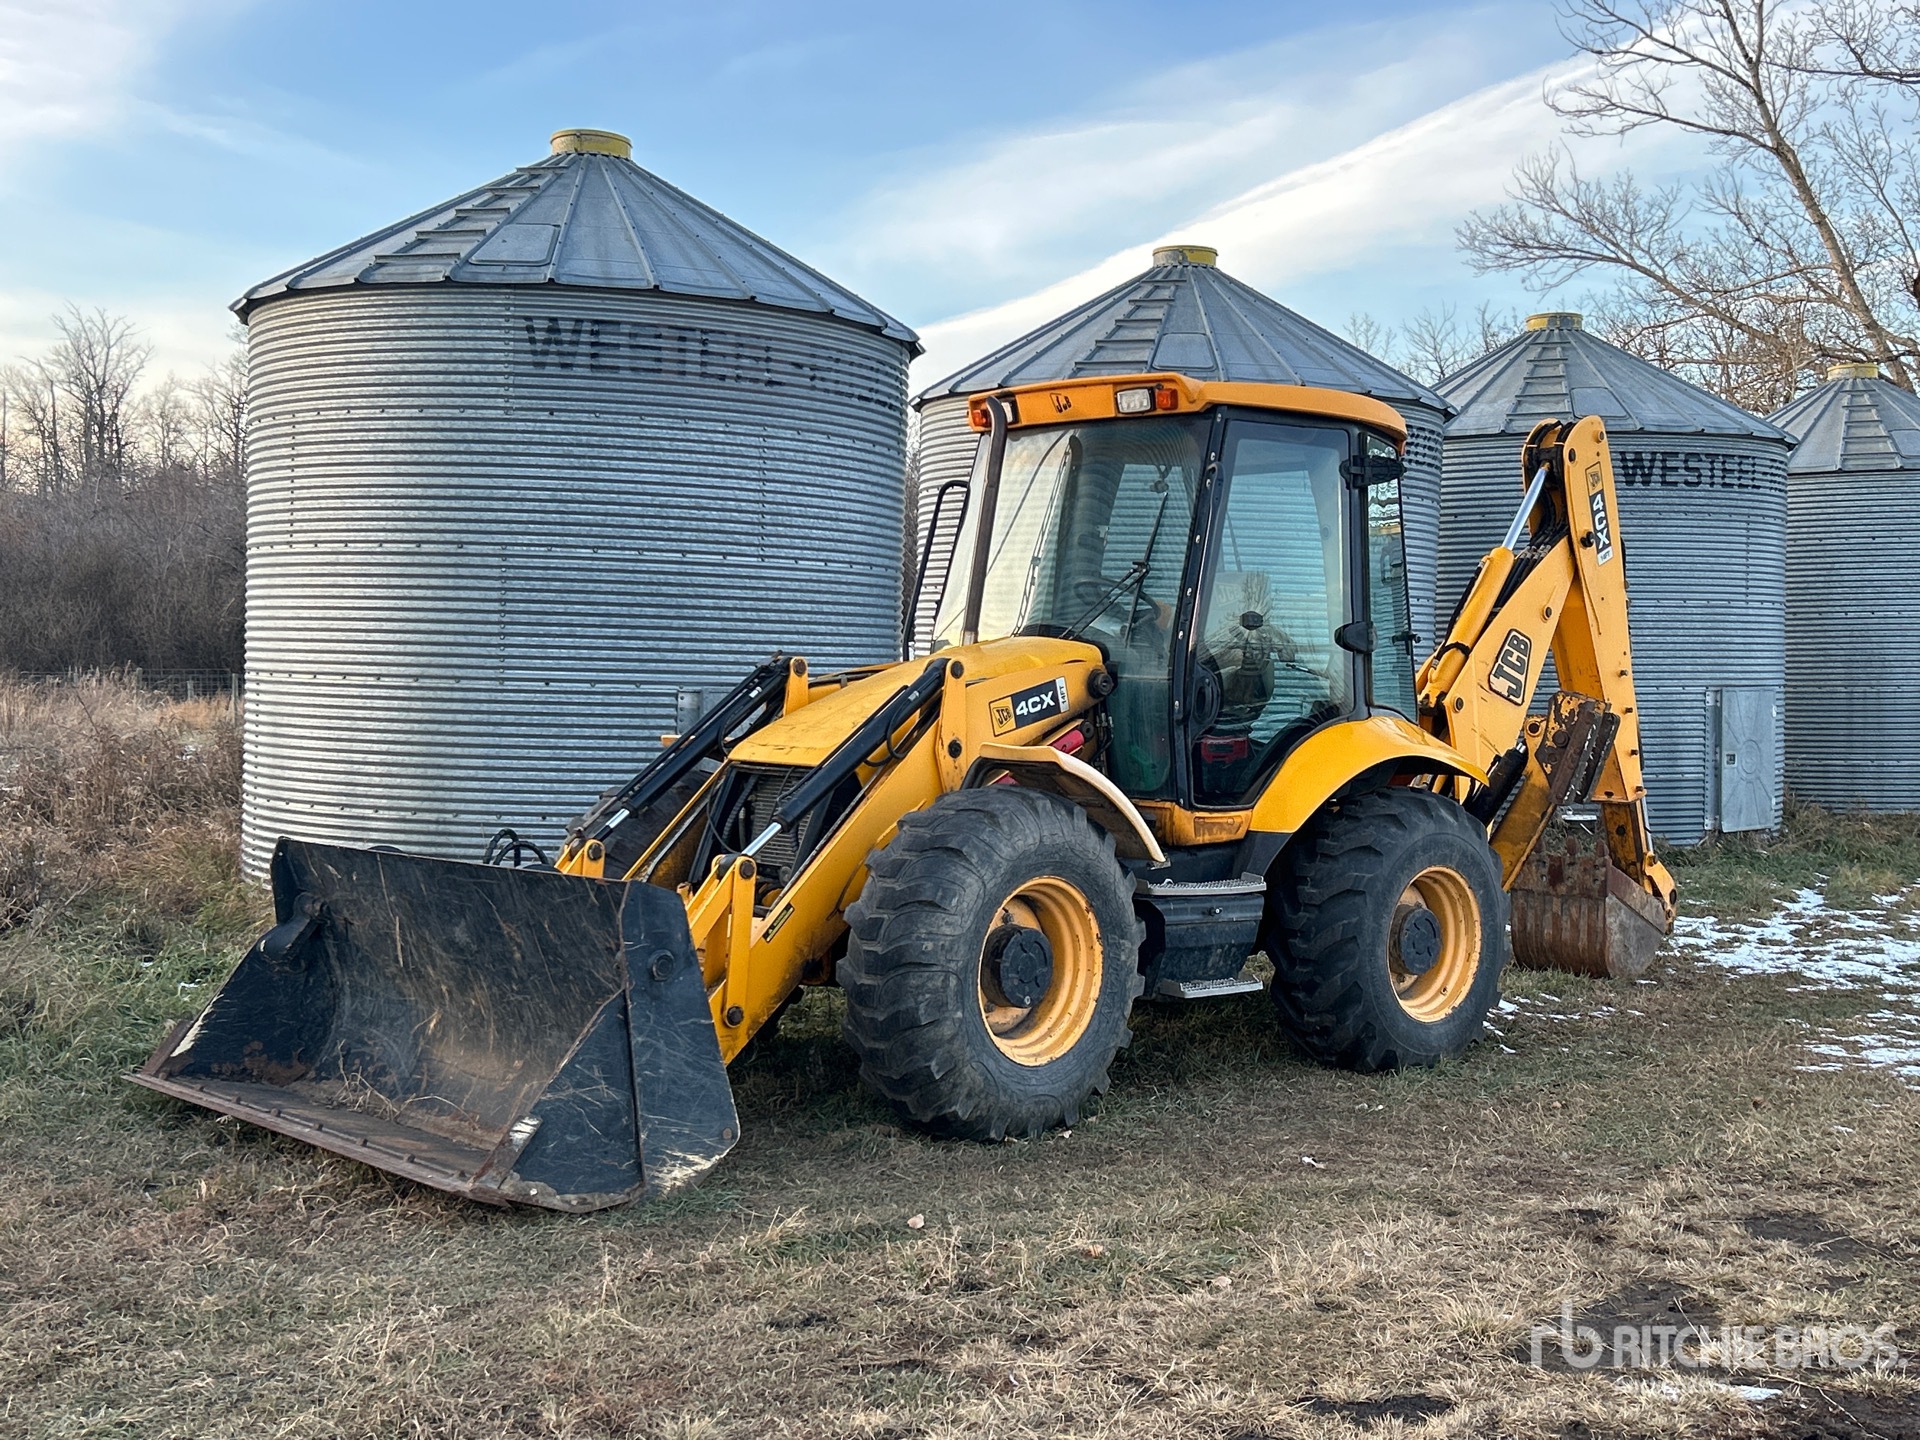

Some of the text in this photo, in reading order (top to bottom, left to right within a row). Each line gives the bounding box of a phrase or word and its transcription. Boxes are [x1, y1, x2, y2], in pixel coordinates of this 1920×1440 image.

[1593, 494, 1610, 549] 4CX
[1492, 634, 1529, 699] JCB
[996, 708, 1012, 725] JCB
[1016, 691, 1056, 716] 4CX
